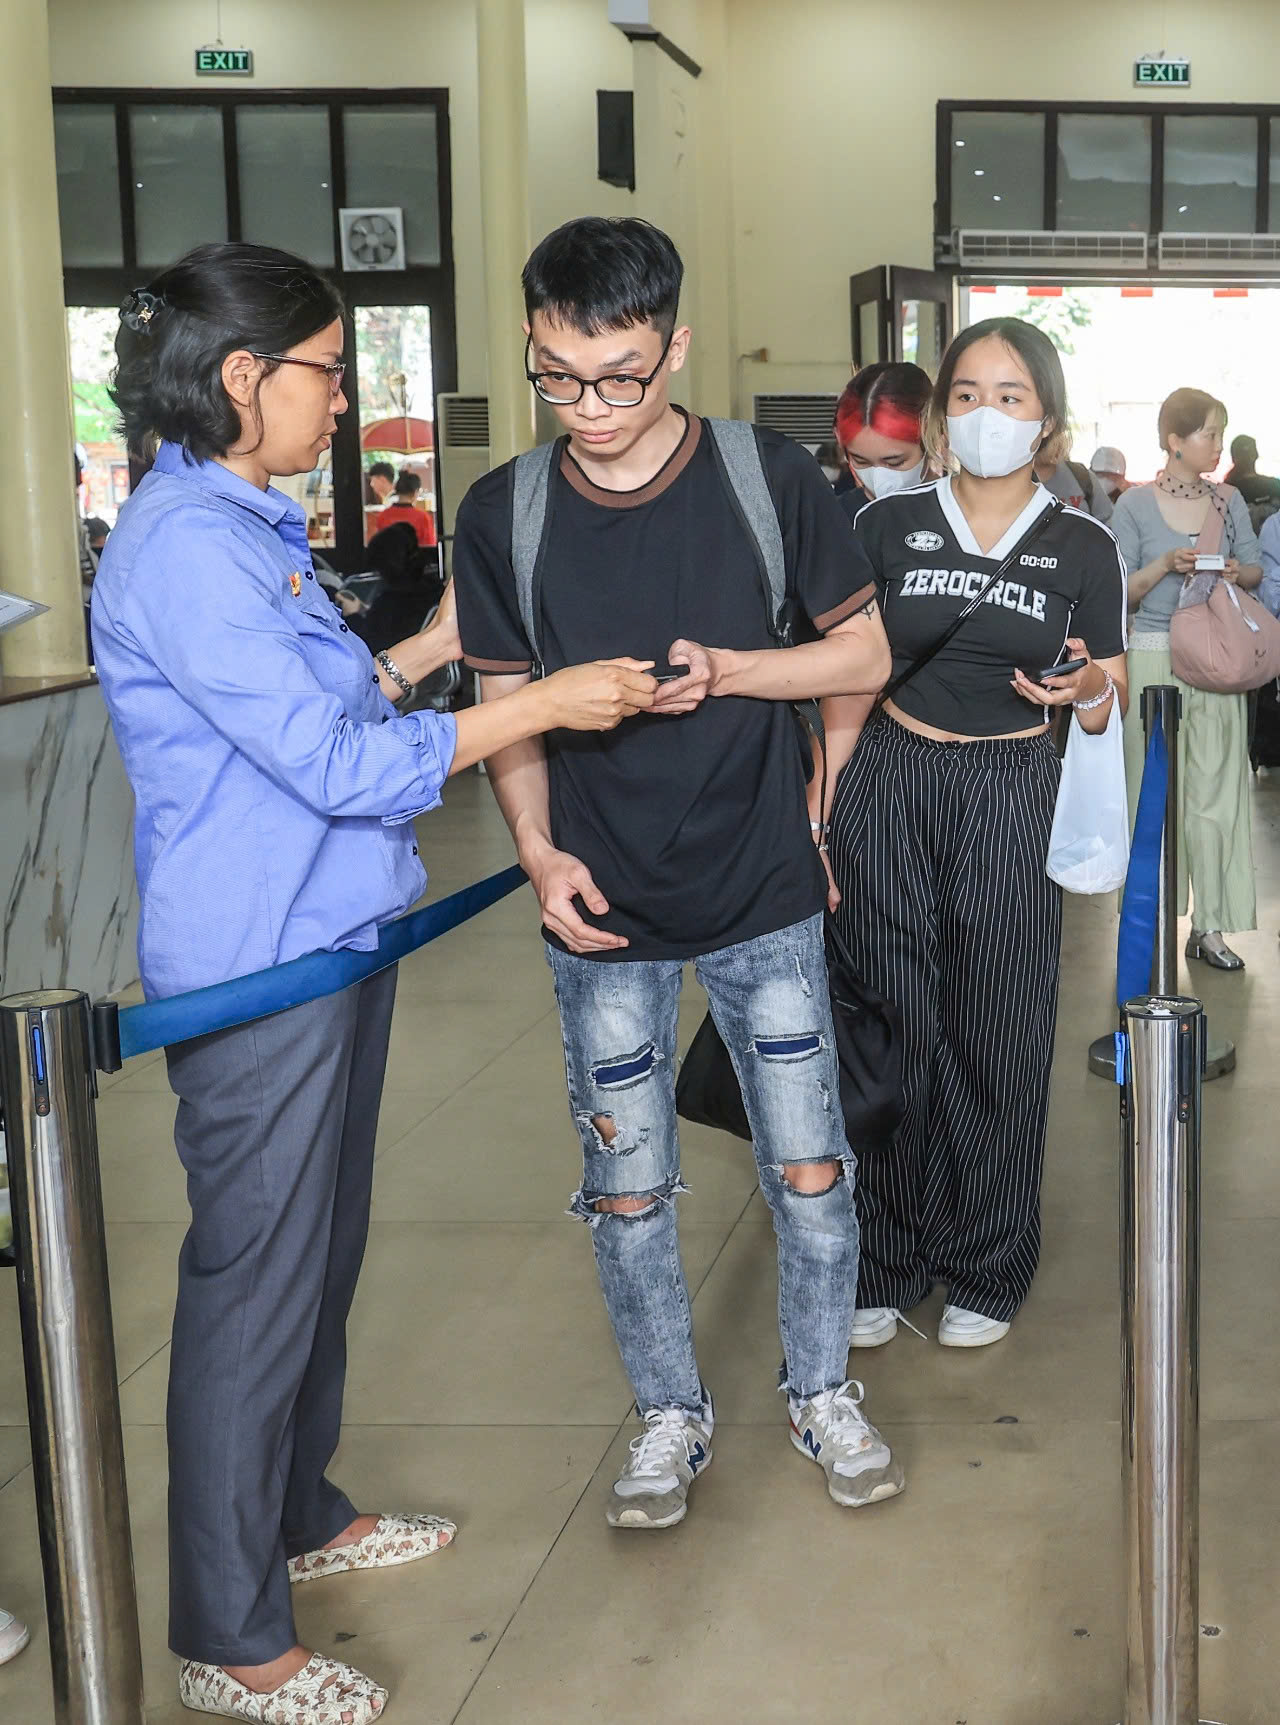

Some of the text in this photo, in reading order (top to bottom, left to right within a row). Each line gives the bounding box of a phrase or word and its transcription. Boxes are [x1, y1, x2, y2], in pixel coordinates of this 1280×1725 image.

[199, 54, 248, 70] EXIT
[1139, 64, 1187, 81] EXIT
[1019, 554, 1057, 569] 00:00
